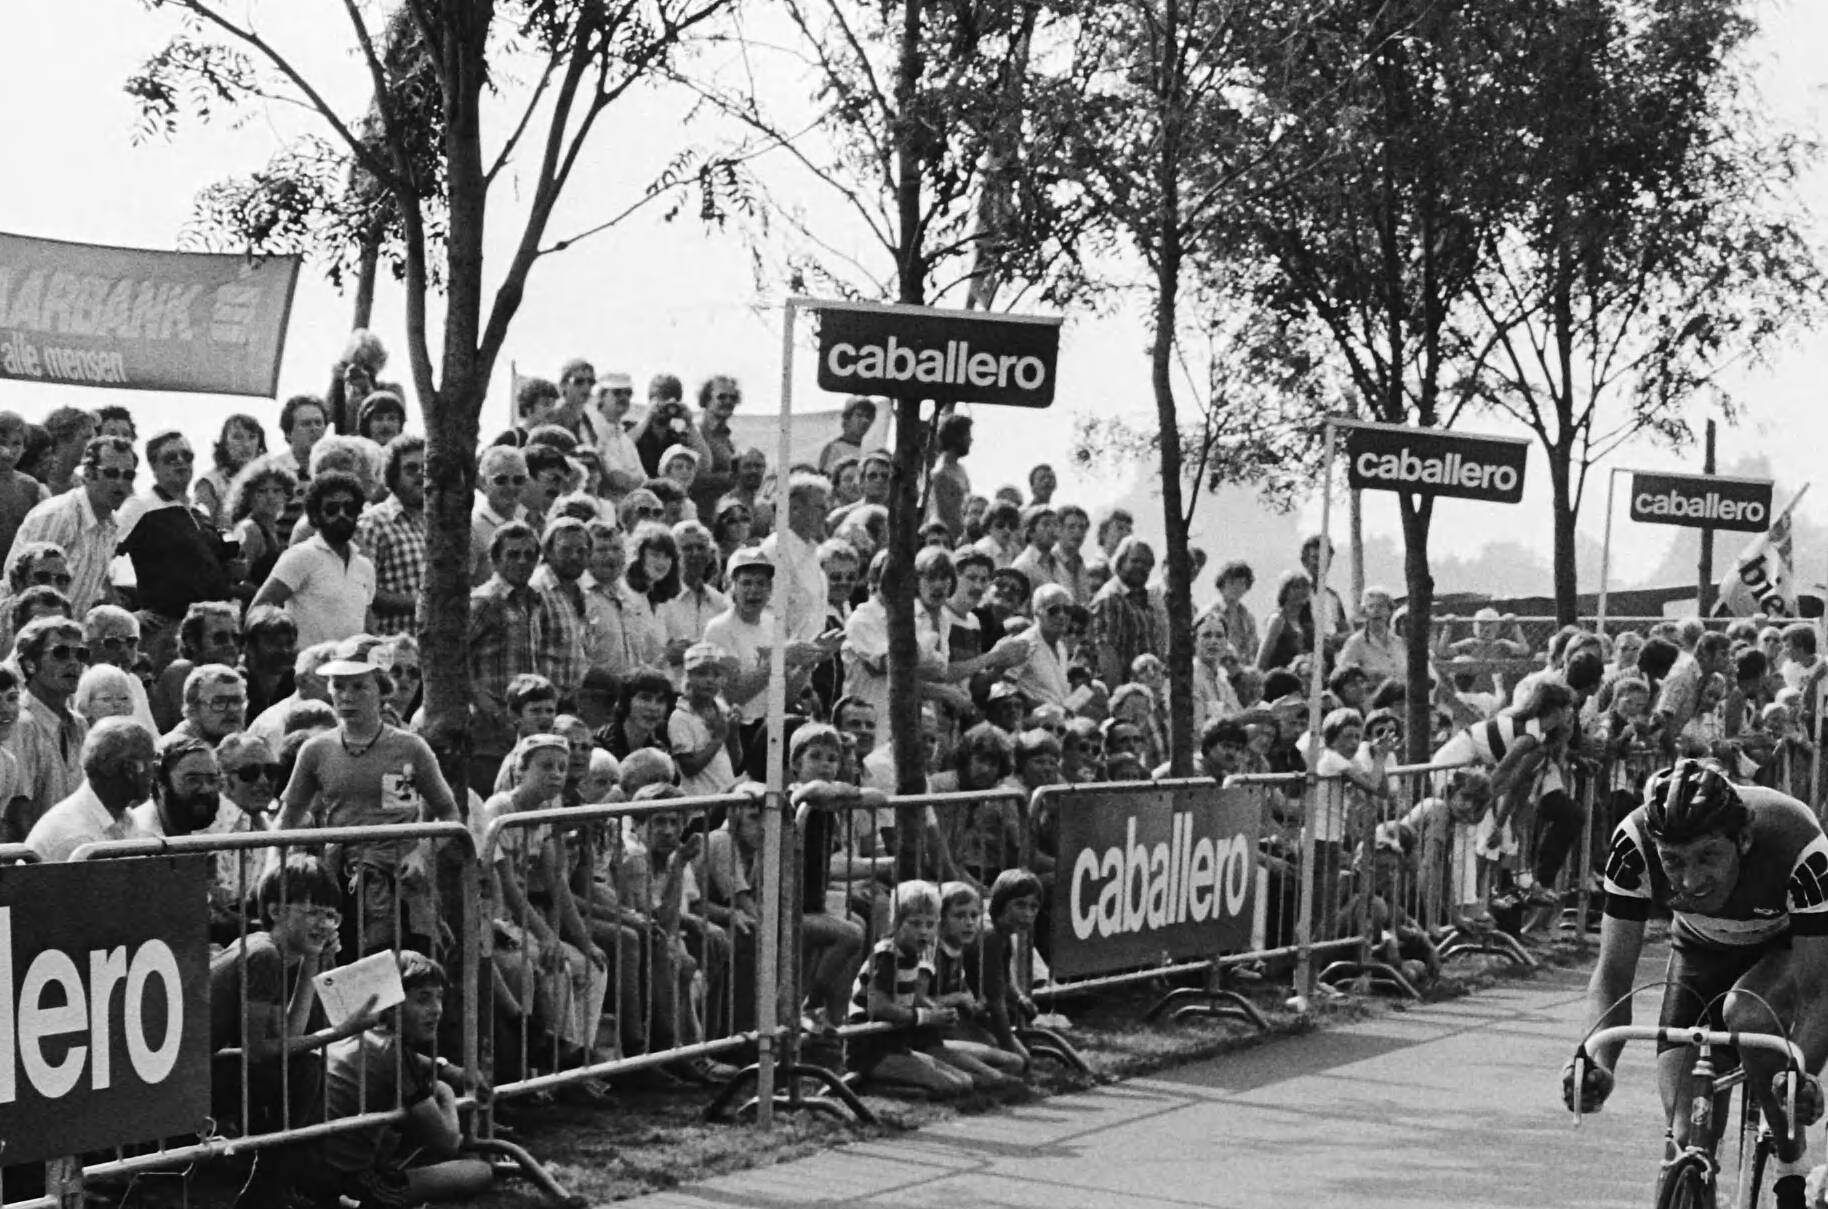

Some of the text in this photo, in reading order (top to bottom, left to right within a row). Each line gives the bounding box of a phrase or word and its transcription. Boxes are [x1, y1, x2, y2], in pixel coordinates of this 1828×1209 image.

[44, 347, 128, 384] mensen
[828, 335, 1046, 390] caballero
[1357, 447, 1518, 491] caballero
[1634, 489, 1765, 523] caballero
[1070, 811, 1249, 940] caballero
[0, 904, 184, 1103] lero
